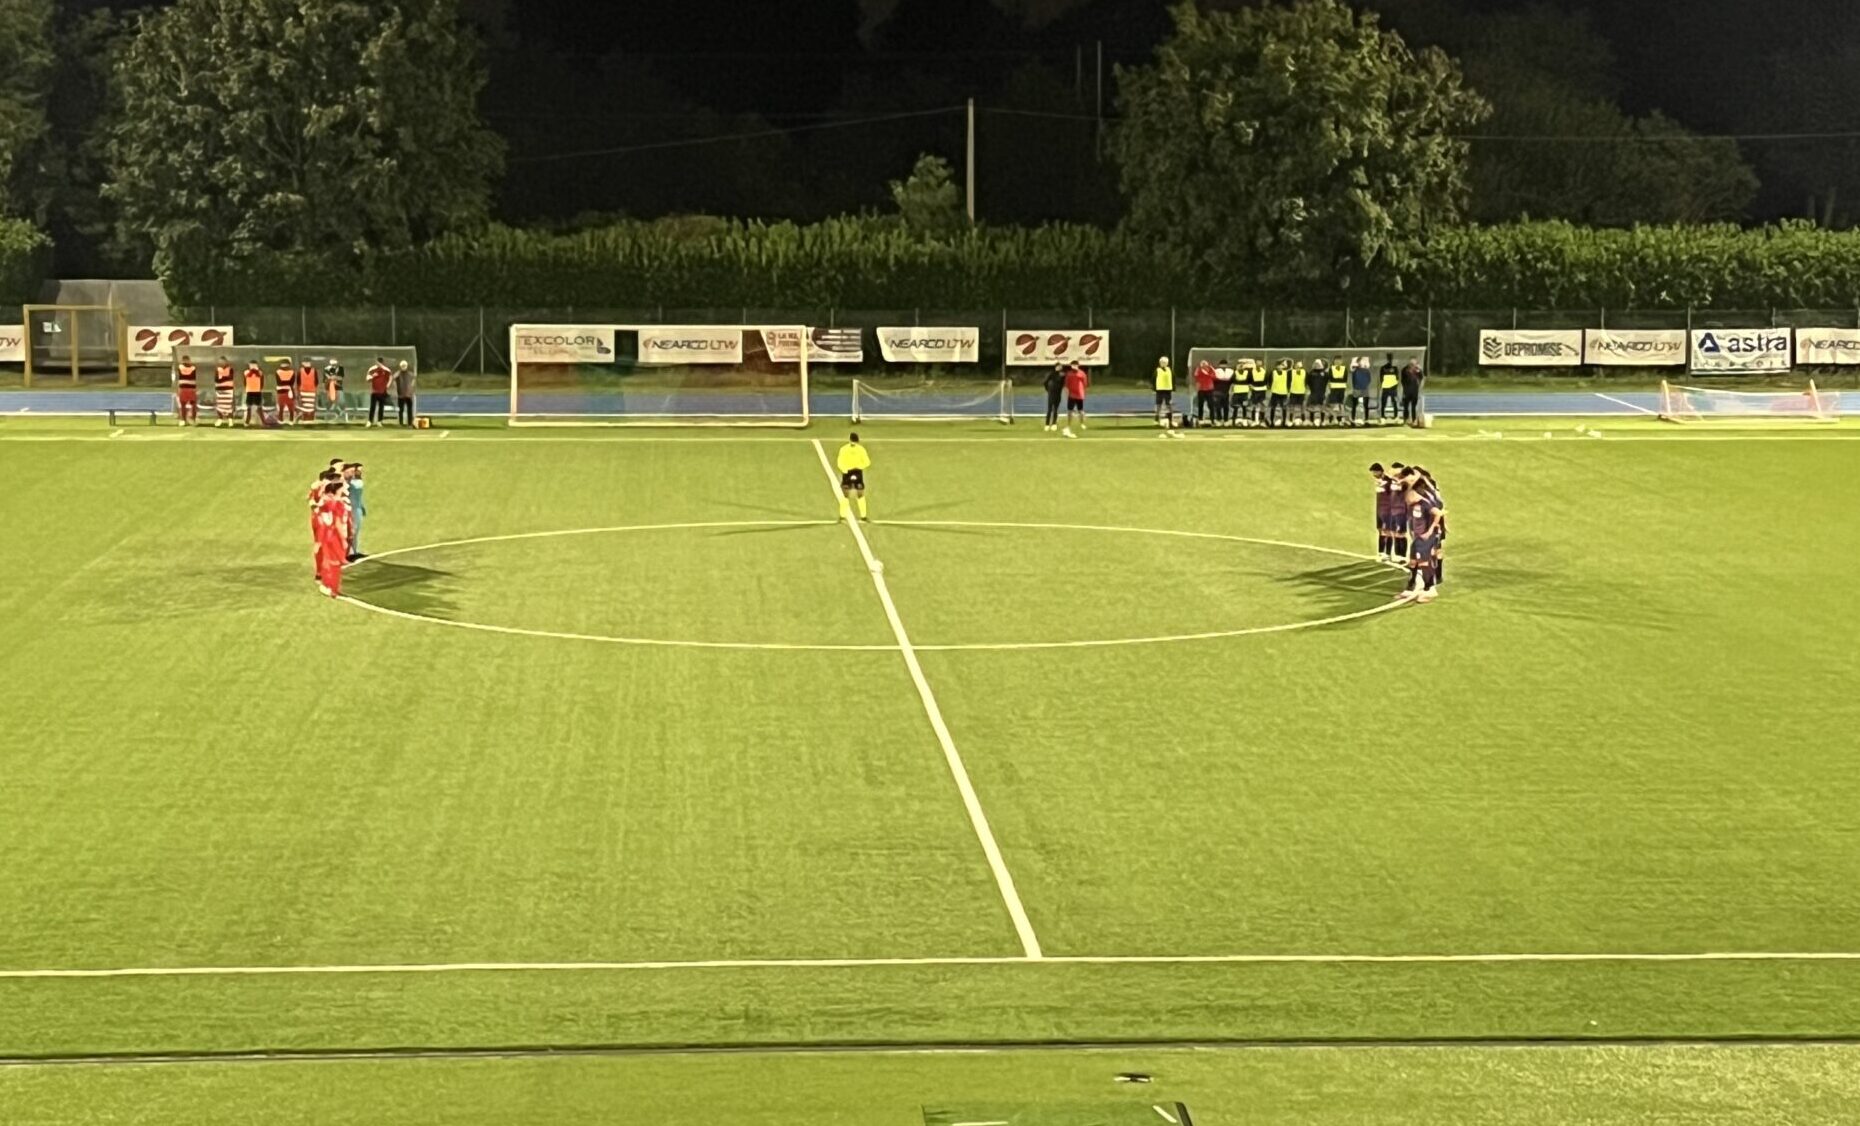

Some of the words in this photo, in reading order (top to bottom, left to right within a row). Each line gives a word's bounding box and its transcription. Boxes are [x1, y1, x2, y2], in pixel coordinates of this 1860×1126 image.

[651, 339, 708, 350] NEARCO
[710, 339, 738, 350] LTW
[890, 338, 945, 349] NEARCO
[947, 338, 975, 349] LTW
[1504, 342, 1562, 356] DEPROMISE
[1727, 333, 1787, 353] astra
